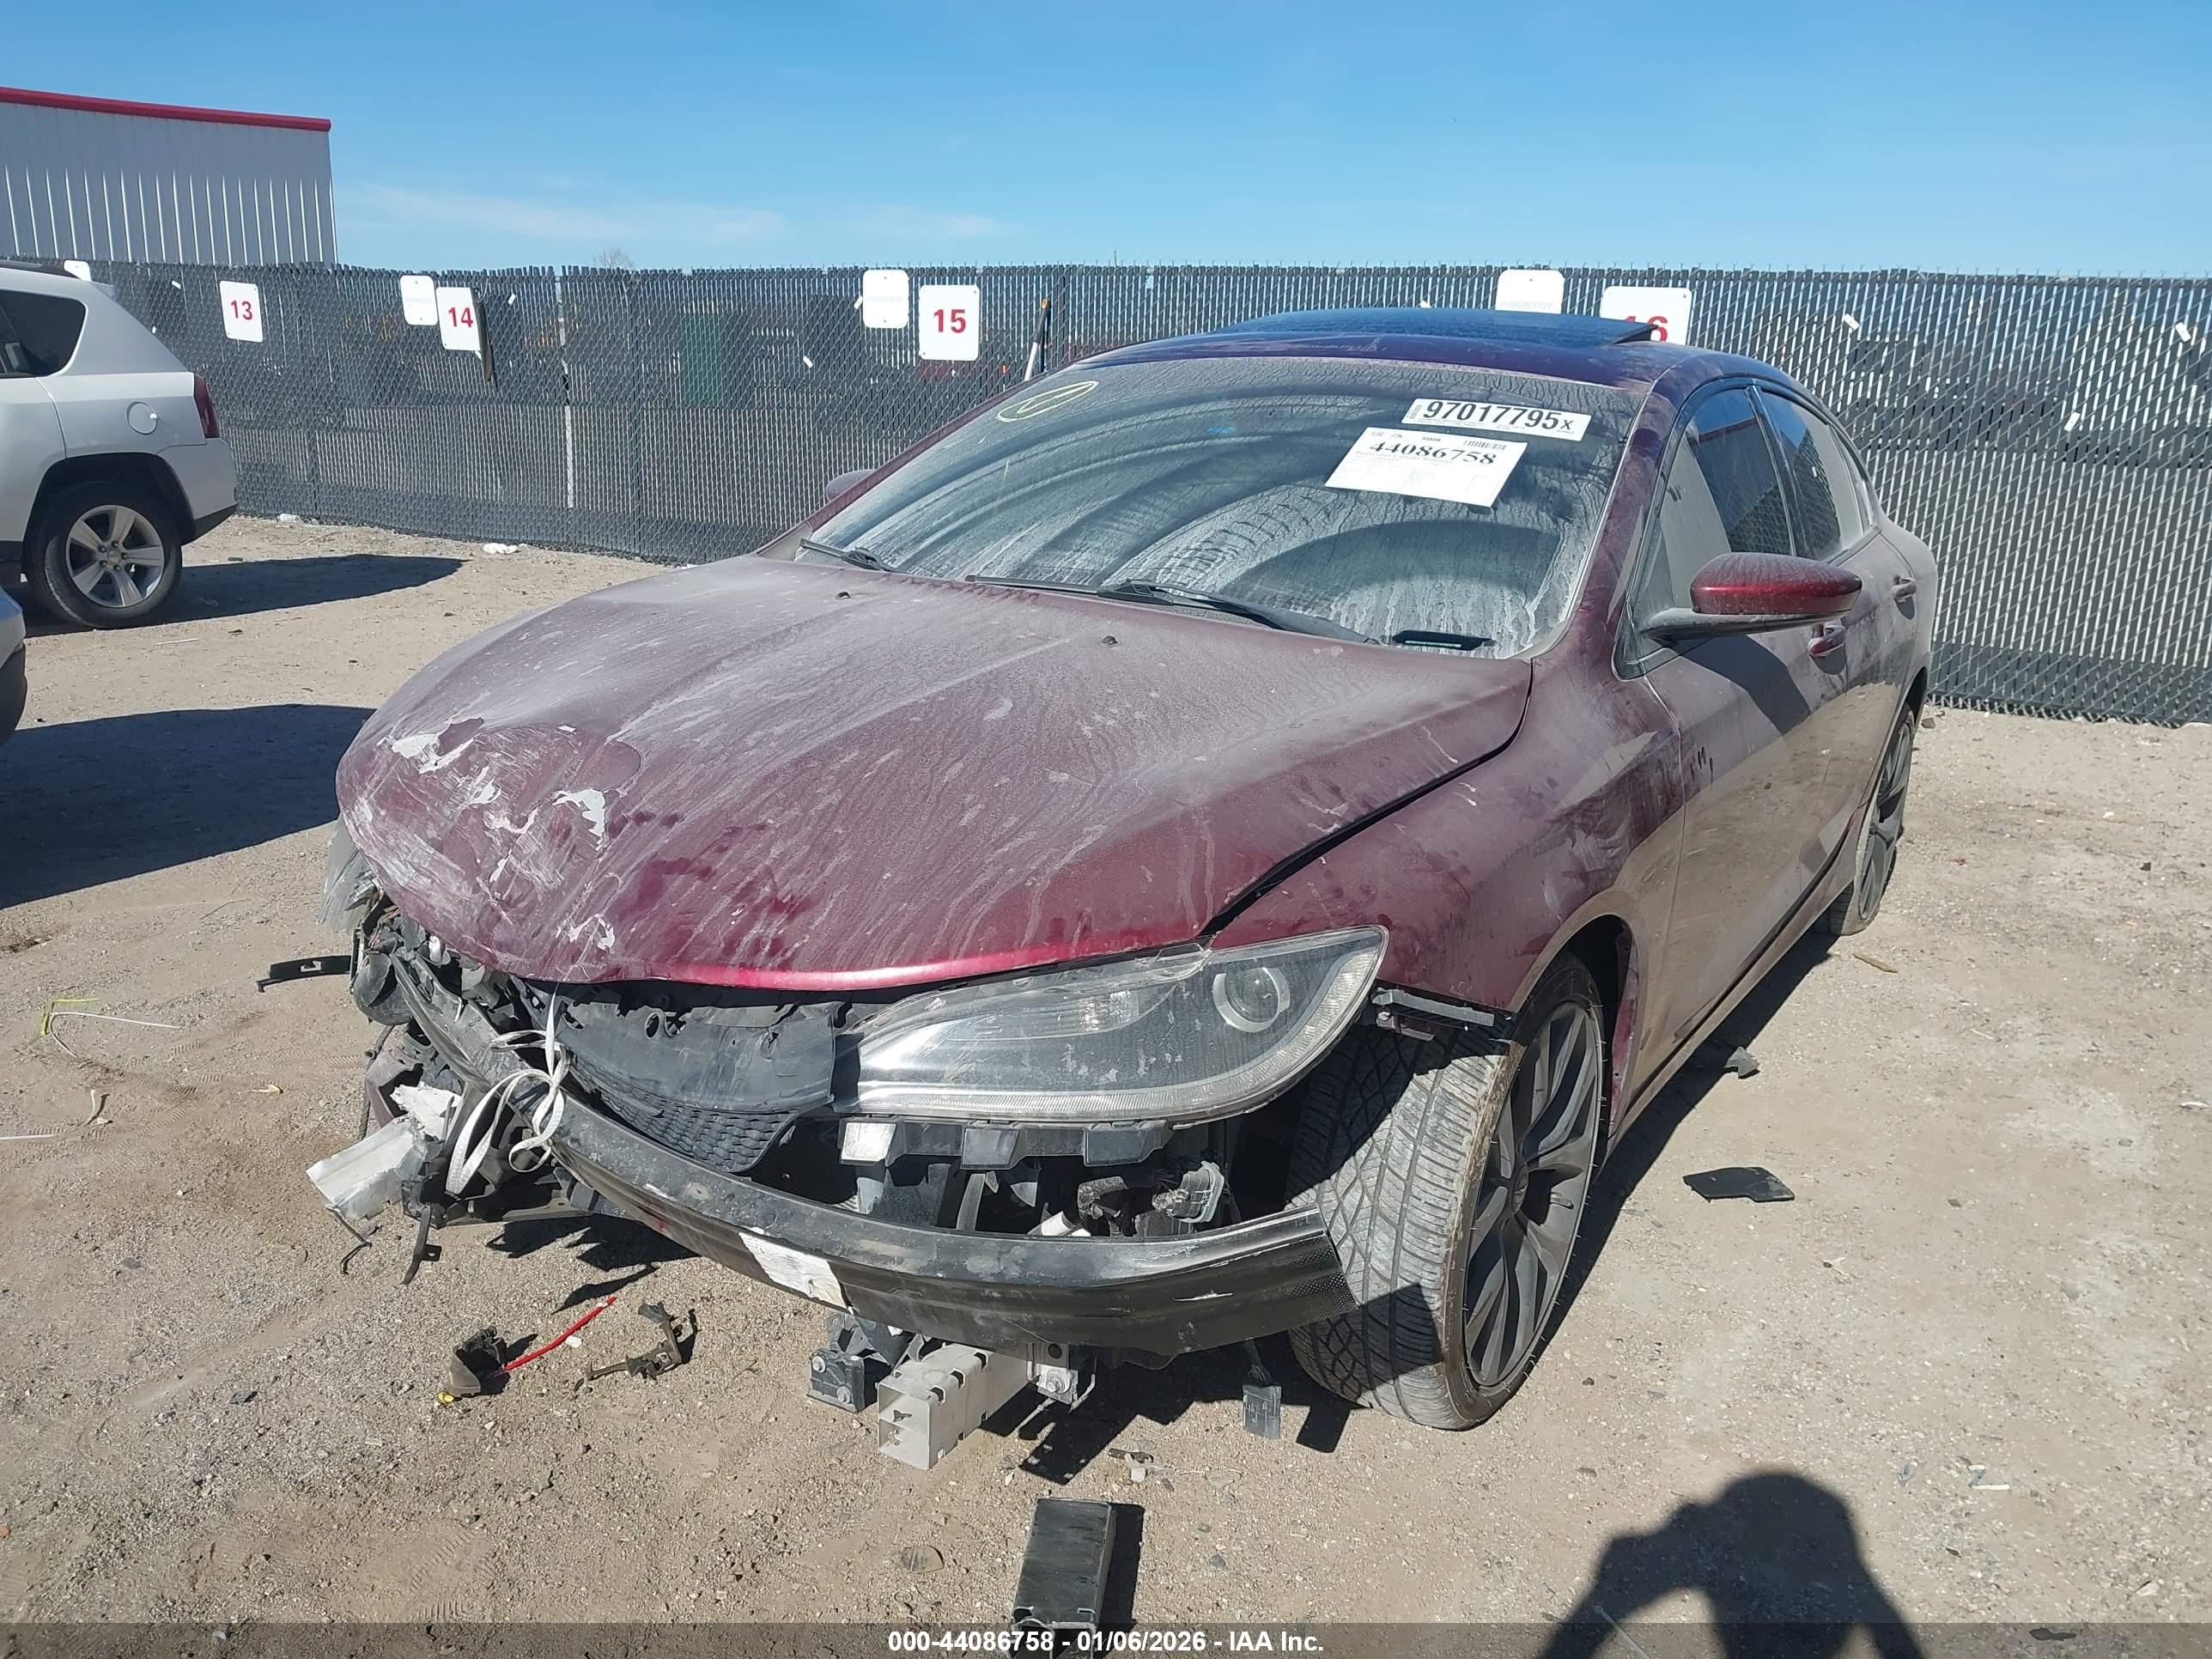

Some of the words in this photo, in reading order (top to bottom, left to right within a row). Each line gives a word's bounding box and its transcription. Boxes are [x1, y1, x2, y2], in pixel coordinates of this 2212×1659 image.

[230, 300, 253, 321] 13
[447, 307, 473, 328] 14
[933, 308, 967, 334] 15
[1624, 315, 1668, 343] 6
[1369, 441, 1497, 465] 44086758
